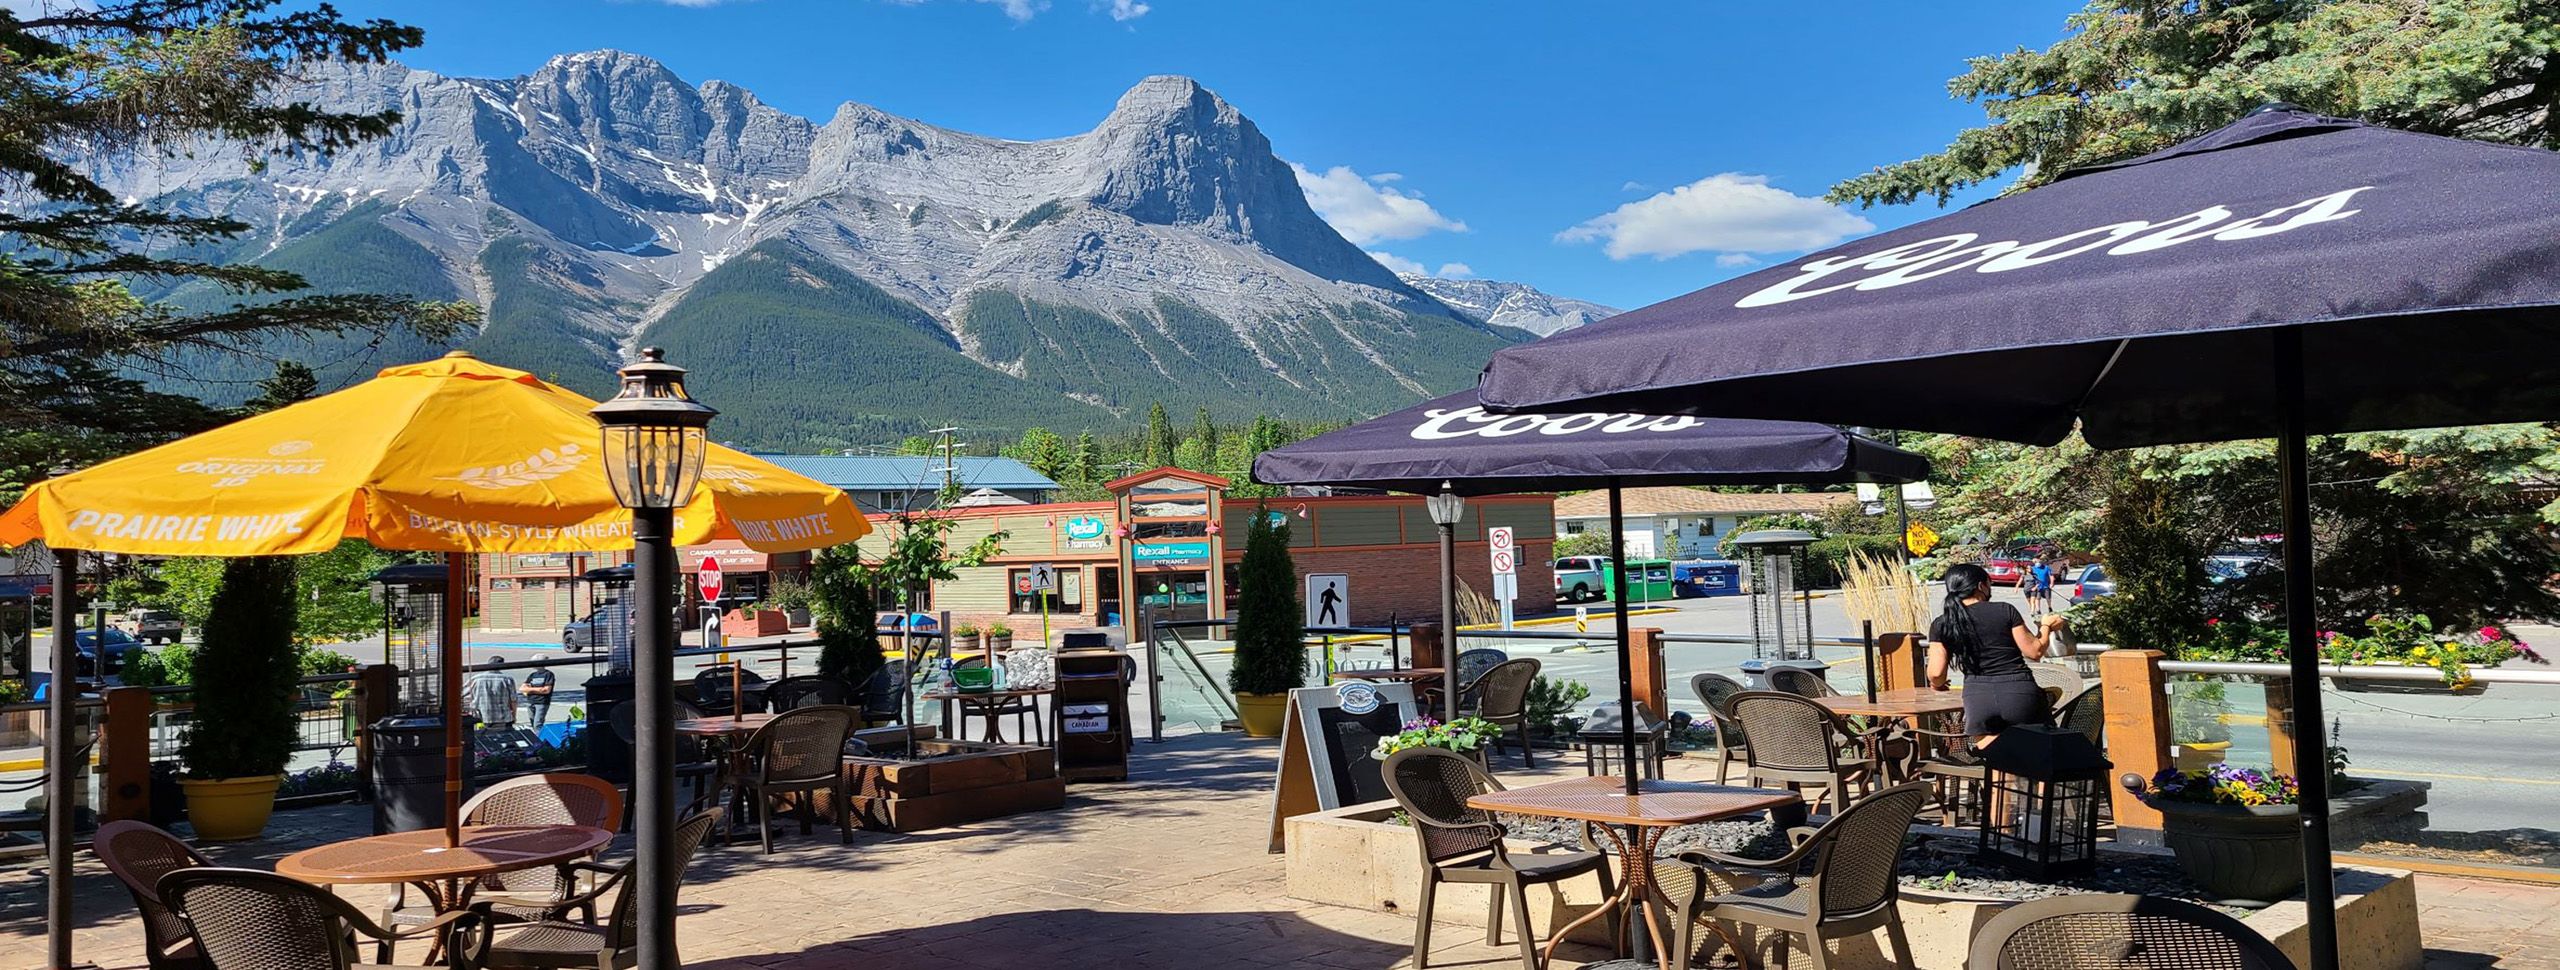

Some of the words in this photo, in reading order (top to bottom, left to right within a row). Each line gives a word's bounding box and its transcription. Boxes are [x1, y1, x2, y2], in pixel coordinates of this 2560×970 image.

[1735, 186, 2375, 307] Coors
[1410, 406, 1704, 440] Coors
[176, 461, 326, 480] ORIGINAL
[69, 510, 212, 541] PRAIRIE
[563, 520, 630, 539] WHEAT
[772, 512, 834, 541] WHITE
[1070, 521, 1098, 536] Rexall
[1067, 541, 1104, 550] Pharmacy
[1137, 546, 1170, 556] Rexall
[1912, 539, 1926, 547] EXIT
[1152, 558, 1190, 566] ENTRANCE
[700, 570, 720, 588] STOP
[1071, 721, 1099, 729] CANADIAN
